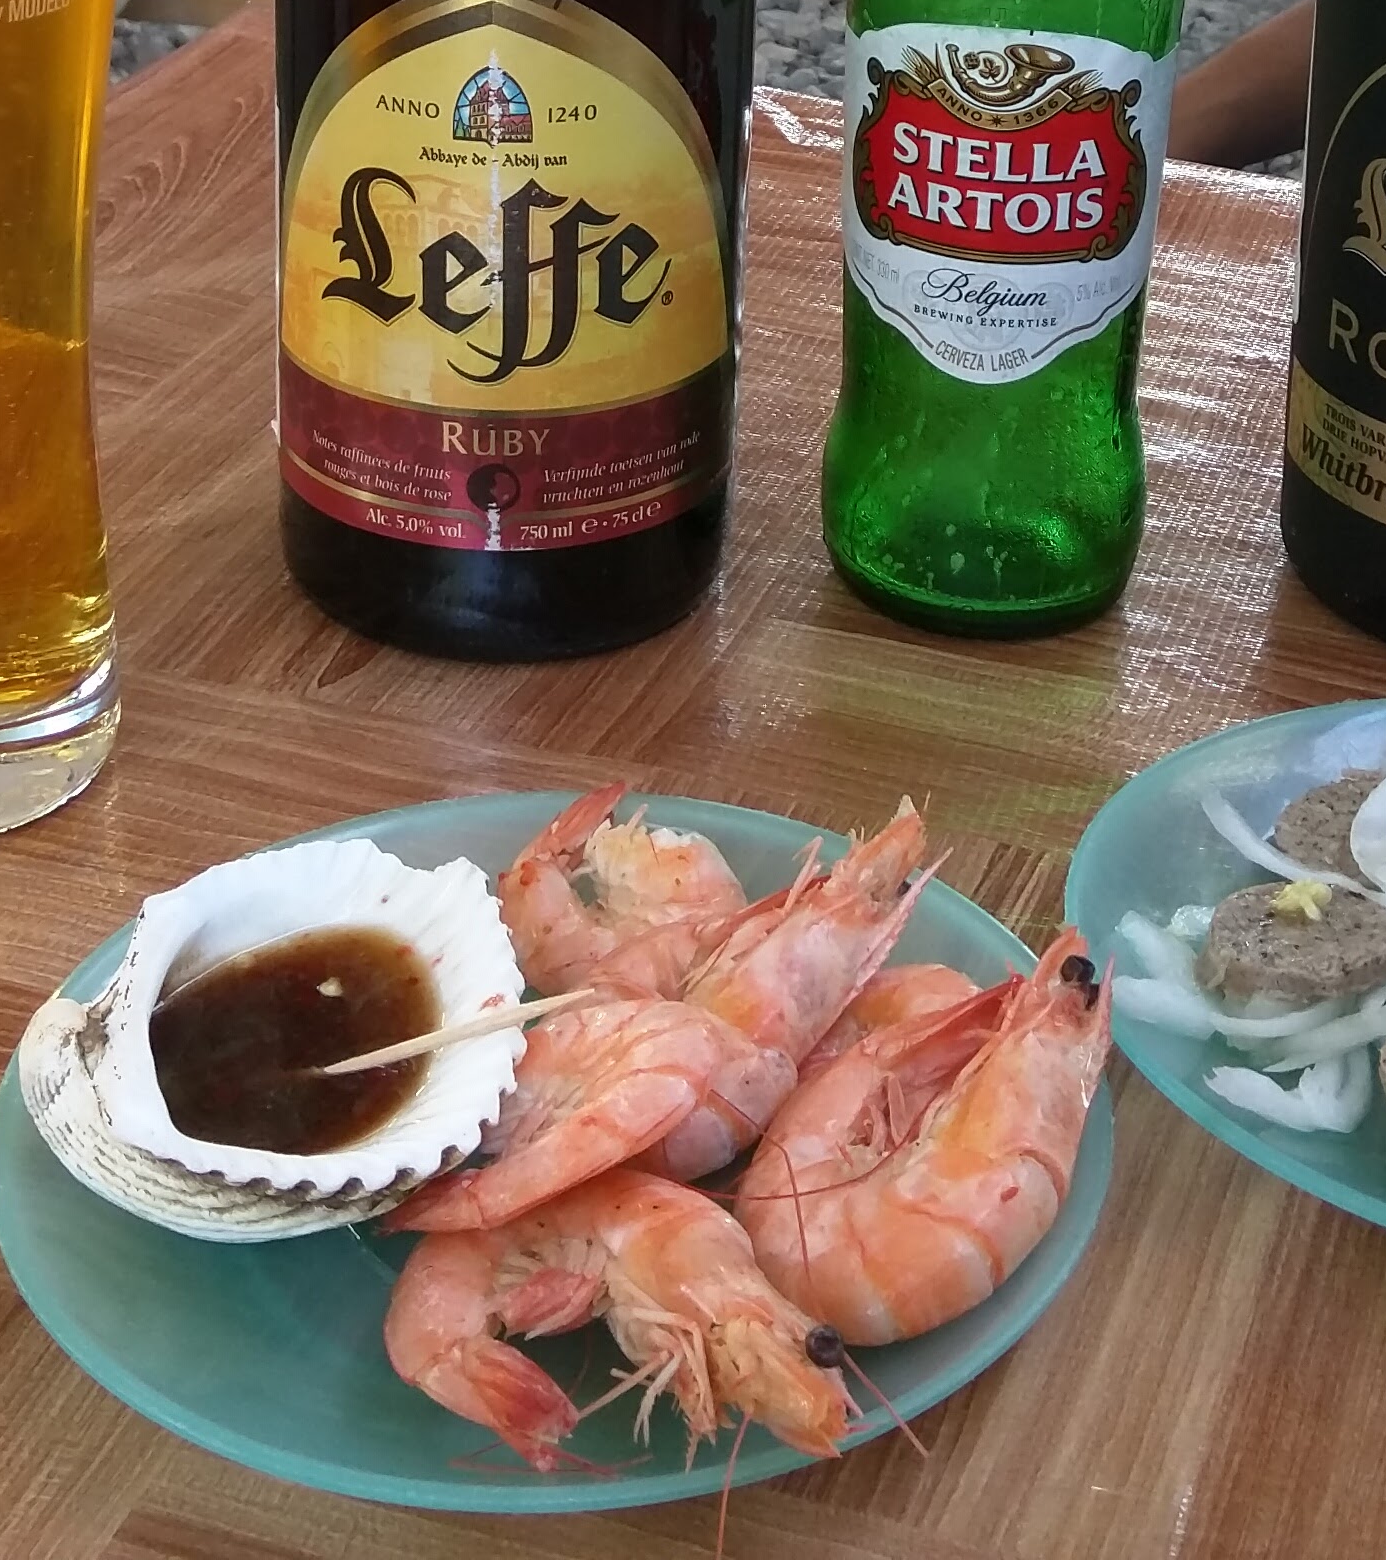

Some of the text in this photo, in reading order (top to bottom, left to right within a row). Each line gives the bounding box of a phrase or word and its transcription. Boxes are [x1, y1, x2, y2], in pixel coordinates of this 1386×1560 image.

[375, 94, 598, 124] ANNO 1240
[936, 87, 1059, 126] ANNO 1366
[418, 146, 469, 168] Abbaye
[471, 153, 487, 167] de
[502, 153, 540, 171] Abdij
[892, 121, 1107, 185] STELLA
[887, 171, 1104, 235] ARTOIS
[321, 166, 672, 384] Leffe
[921, 267, 1049, 317] Belgium
[913, 303, 1058, 329] BREWING EXPERTISE
[935, 340, 1029, 372] CERVEZA LAGER
[1322, 418, 1347, 444] DRIE
[1324, 402, 1357, 432] TROIS
[313, 429, 452, 481] Notes raffinées de fruits
[441, 420, 551, 457] RUBY
[324, 458, 452, 502] rouges et bois de rose
[542, 459, 685, 504] vruchten en rozenhout
[543, 462, 607, 484] Verfijnde
[610, 452, 653, 474] toetsen
[656, 445, 677, 461] van
[366, 507, 392, 528] Alc.
[439, 522, 467, 539] vol.
[520, 525, 549, 541] 750
[552, 521, 573, 538] ml
[612, 511, 629, 529] 75
[632, 505, 644, 523] cl
